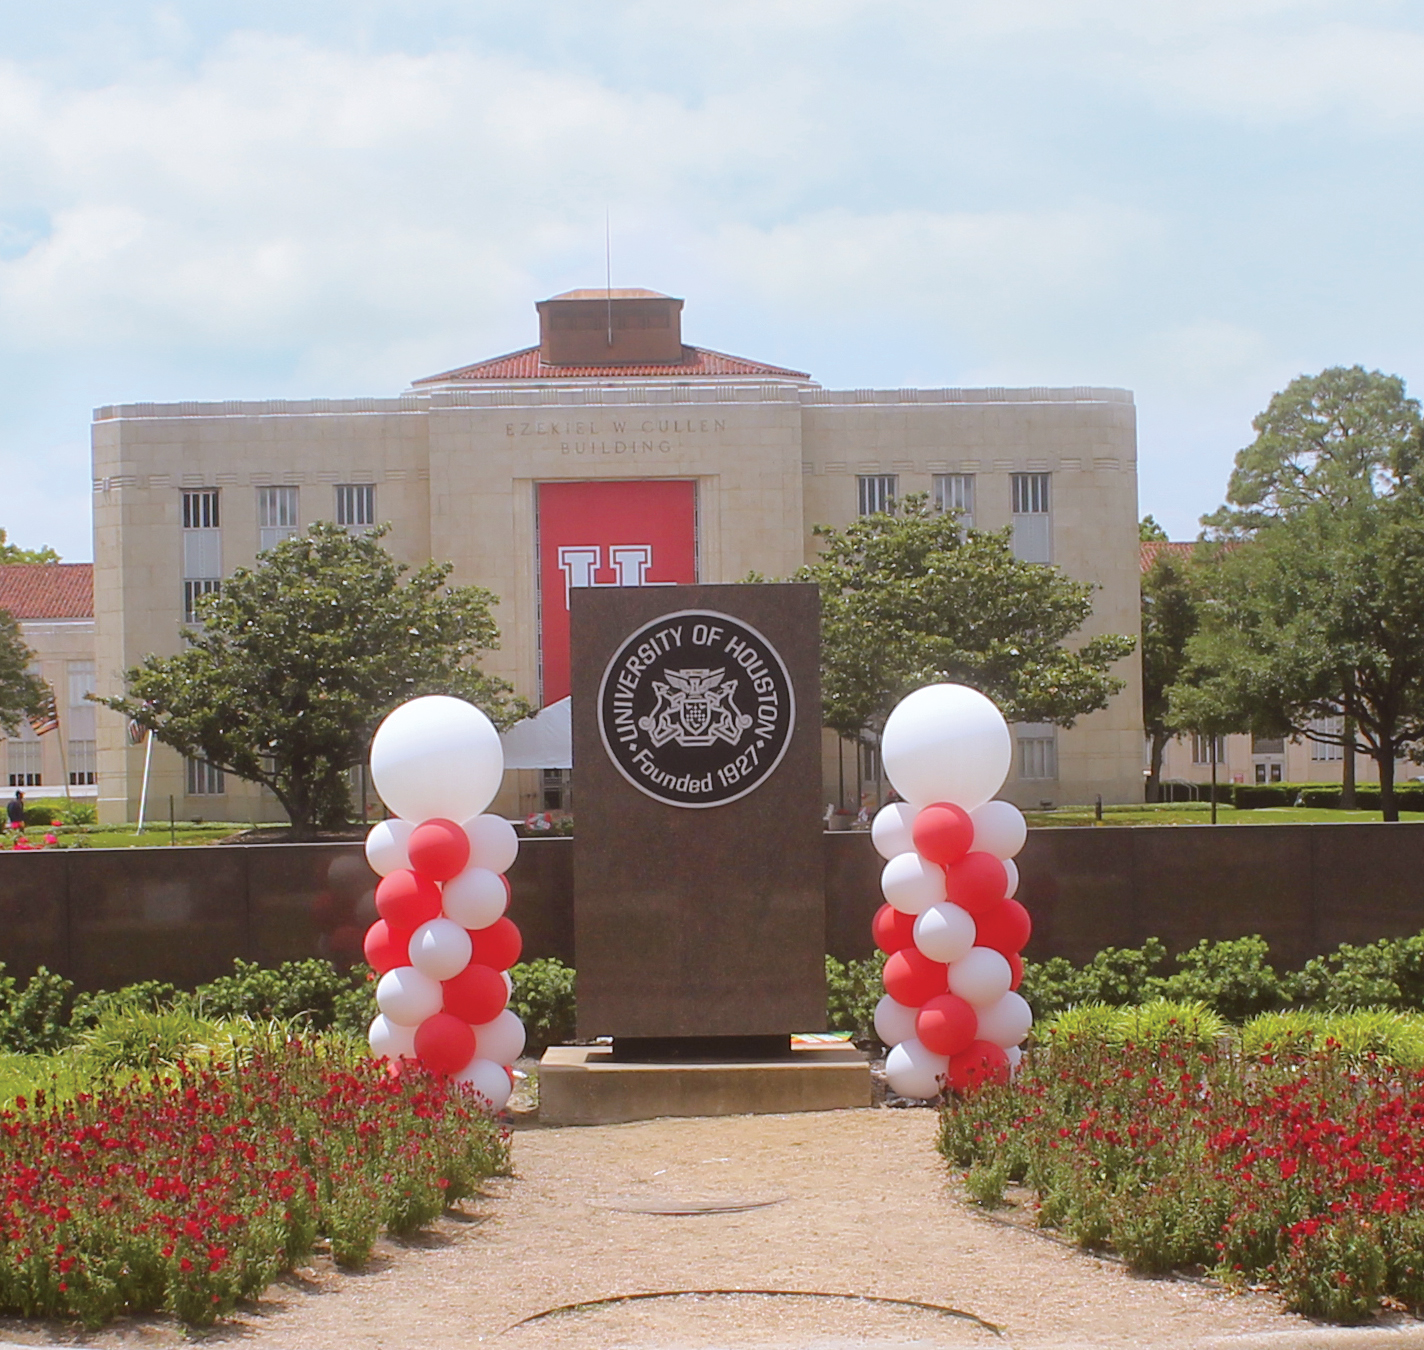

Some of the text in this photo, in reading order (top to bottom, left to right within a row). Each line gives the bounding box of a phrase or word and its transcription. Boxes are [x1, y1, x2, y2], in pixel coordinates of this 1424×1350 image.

[505, 419, 726, 436] EZEKIEL W CULLEN
[561, 441, 672, 455] BUILDING
[614, 624, 779, 743] UNIVERSITY OF HOUSTON
[632, 745, 760, 793] Founded 1927
